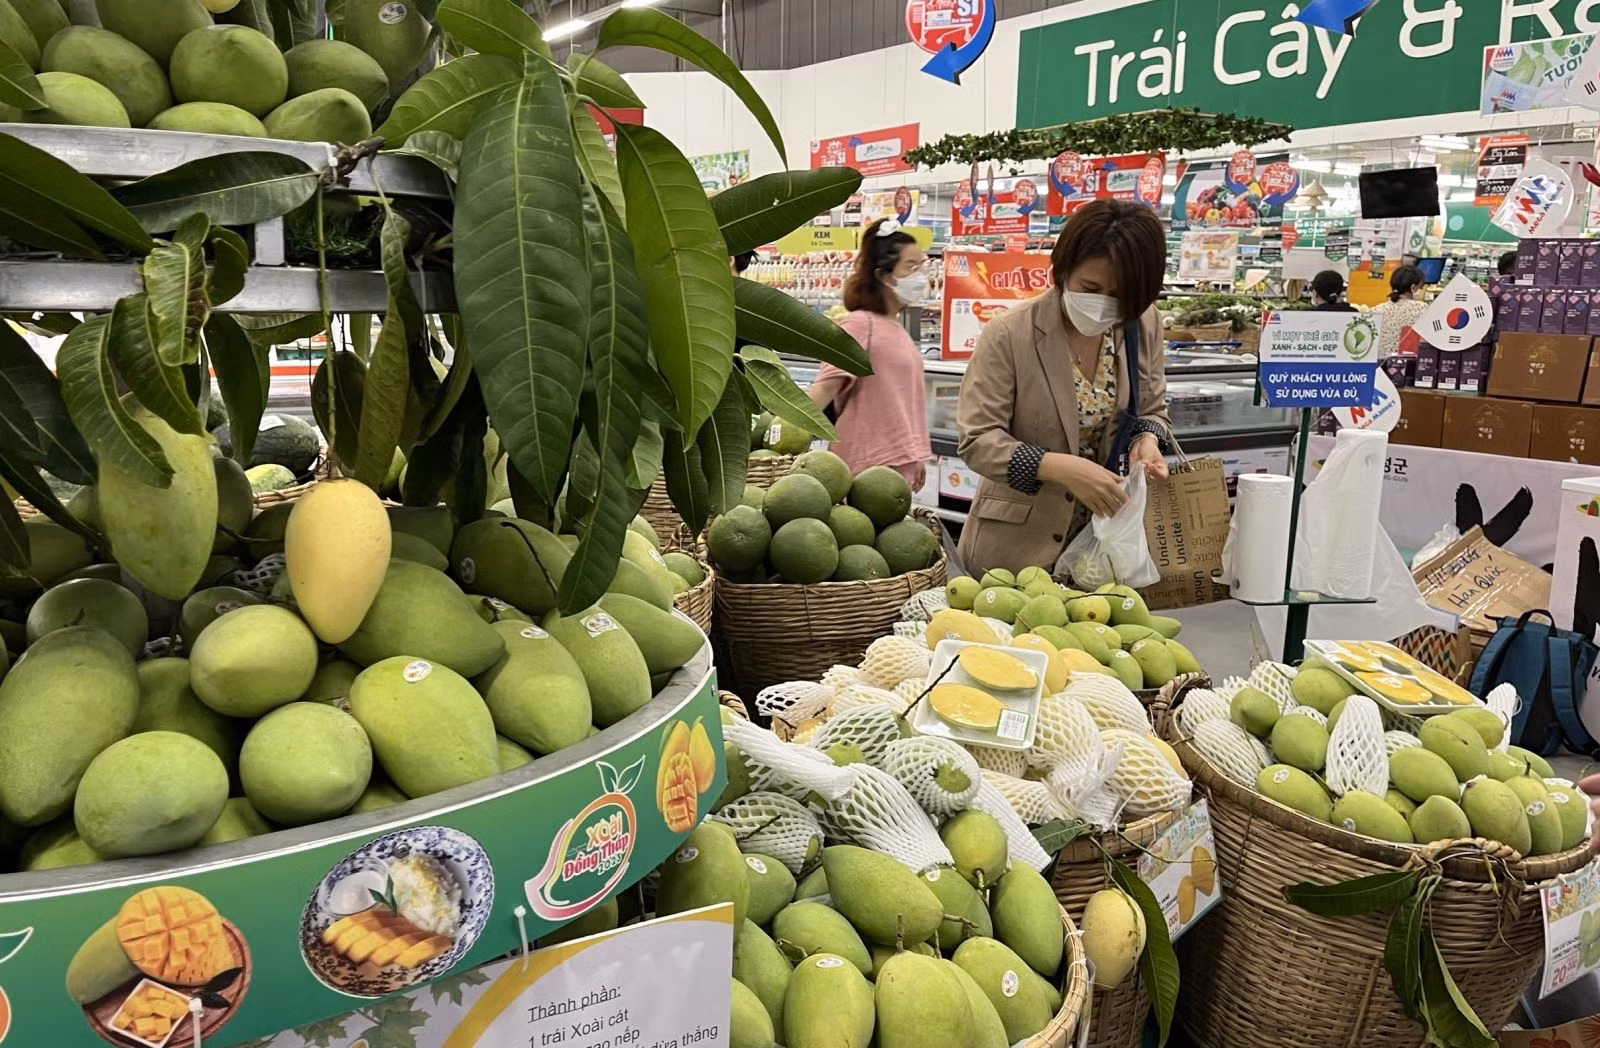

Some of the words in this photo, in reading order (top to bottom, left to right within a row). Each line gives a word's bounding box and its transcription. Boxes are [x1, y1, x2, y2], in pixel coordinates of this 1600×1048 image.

[1074, 28, 1187, 107] Trái
[1213, 2, 1362, 100] Cây
[1399, 0, 1463, 58] &
[814, 231, 831, 239] KEM
[1297, 344, 1317, 352] SẠCH
[1323, 344, 1338, 352] ĐẸP
[1290, 372, 1323, 383] KHÁCH
[1325, 374, 1341, 383] VUI
[1342, 372, 1368, 383] LÒNG
[1291, 389, 1318, 400] DỤNG
[562, 851, 600, 881] Đồng
[599, 833, 630, 861] Tháp
[597, 854, 622, 875] 2023
[528, 998, 577, 1023] Thành
[581, 985, 622, 1011] phần:
[528, 1036, 536, 1048] 1
[541, 1026, 566, 1046] trái
[571, 1017, 604, 1040] Xoài
[608, 1008, 630, 1027] cát
[615, 1026, 641, 1048] nếp
